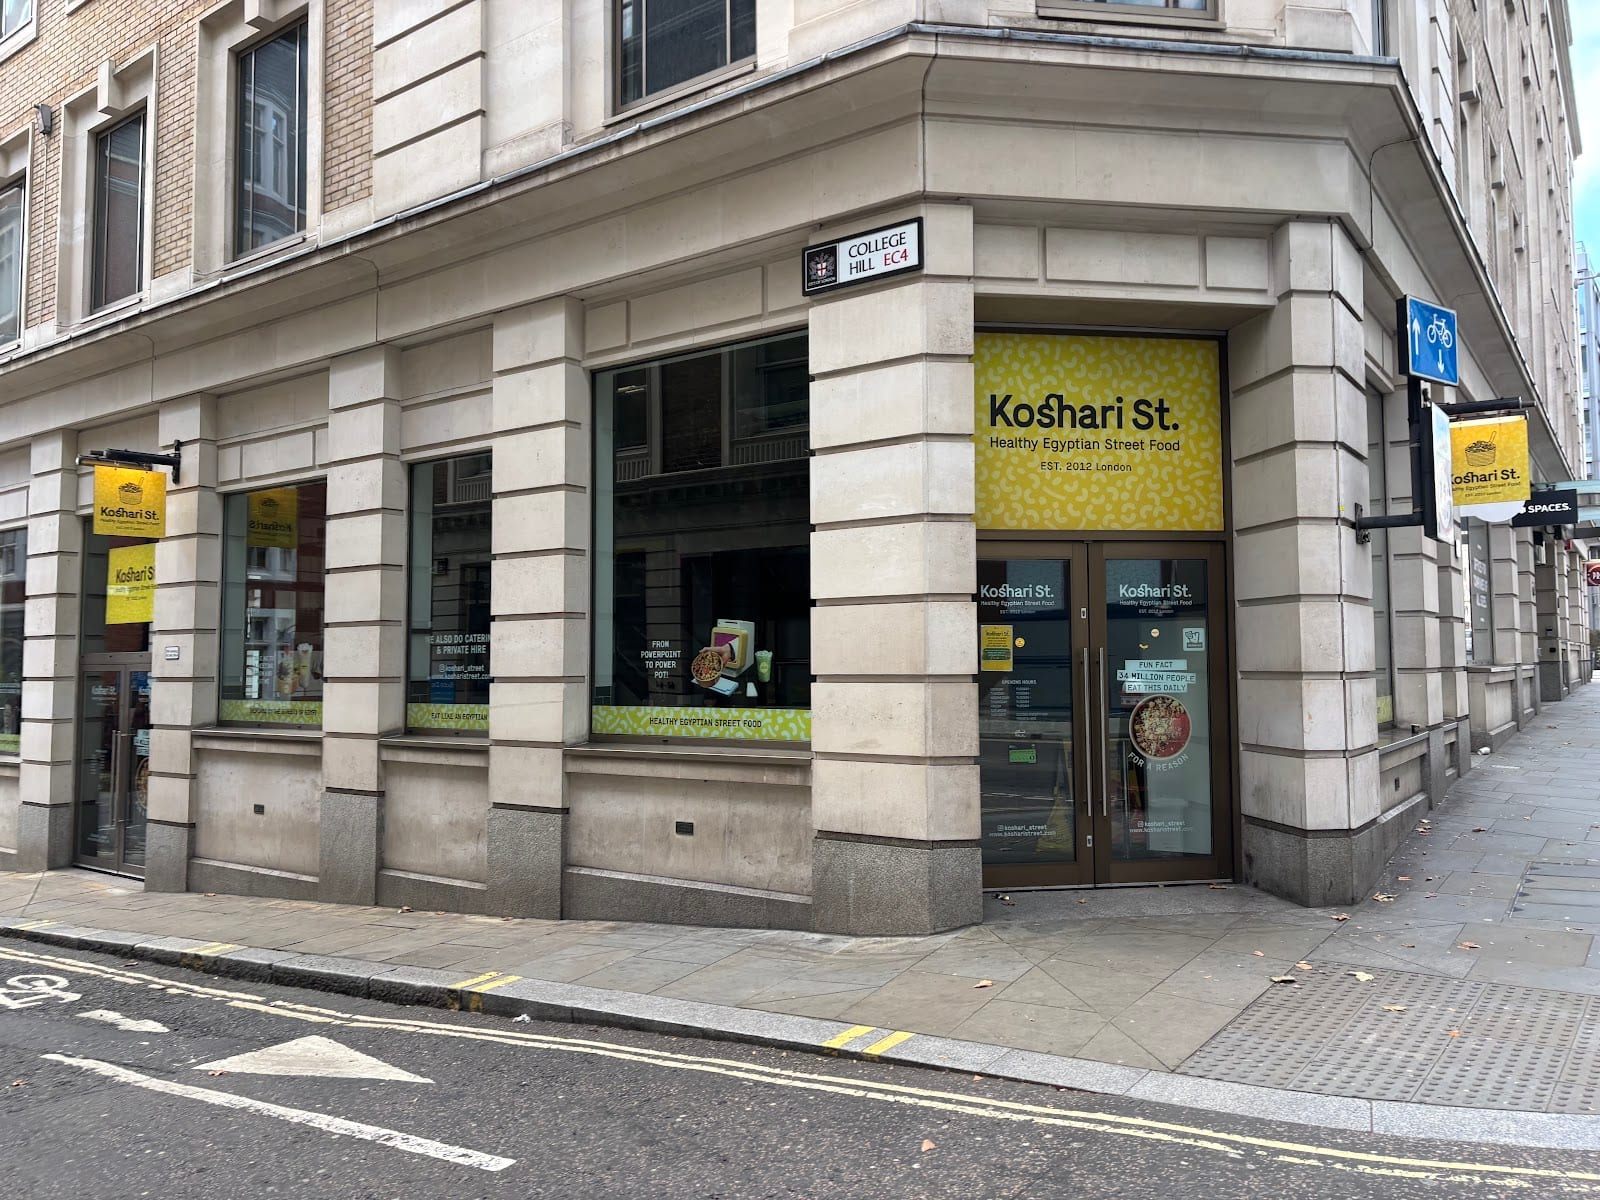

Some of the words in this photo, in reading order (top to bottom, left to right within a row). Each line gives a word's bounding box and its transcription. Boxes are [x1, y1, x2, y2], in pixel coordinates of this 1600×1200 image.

[848, 231, 907, 258] COLLEGE
[849, 257, 876, 275] HILL
[884, 248, 909, 267] EC4
[990, 393, 1123, 429] Koshari
[1132, 398, 1180, 431] St.
[990, 437, 1038, 451] Healthy
[1043, 438, 1100, 452] Egyptian
[1104, 439, 1145, 451] Street
[1149, 440, 1180, 451] Food
[1040, 462, 1062, 471] EST.
[1066, 462, 1092, 471] 2012
[1096, 463, 1132, 471] London
[1501, 468, 1520, 480] St.
[100, 506, 143, 519] Koshari
[144, 510, 160, 520] St.
[1527, 502, 1572, 514] SPACES.
[115, 564, 147, 584] Koshari
[980, 583, 1033, 598] Koshari
[1035, 584, 1055, 598] St.
[1119, 583, 1171, 598] Koshari
[1173, 584, 1192, 598] St.
[436, 634, 453, 644] ALSO
[454, 634, 463, 643] DO
[652, 640, 670, 648] FROM
[443, 645, 469, 654] PRIVATE
[470, 645, 487, 654] HIRE
[640, 650, 681, 659] POWERPOINT
[645, 661, 654, 669] TO
[655, 661, 676, 669] POWER
[1139, 661, 1154, 669] FUN
[654, 671, 669, 679] POT!
[1131, 672, 1165, 681] MILLION
[1166, 674, 1196, 682] PEOPLE
[1127, 684, 1142, 692] EAT
[1144, 684, 1162, 692] THIS
[1163, 684, 1186, 692] DAILY
[650, 717, 677, 725] HEALTHY
[680, 718, 713, 727] EGYPTIAN
[714, 719, 741, 727] STREET
[743, 720, 762, 728] FOOD
[1128, 751, 1145, 767] FOR
[1155, 753, 1190, 772] REASON
